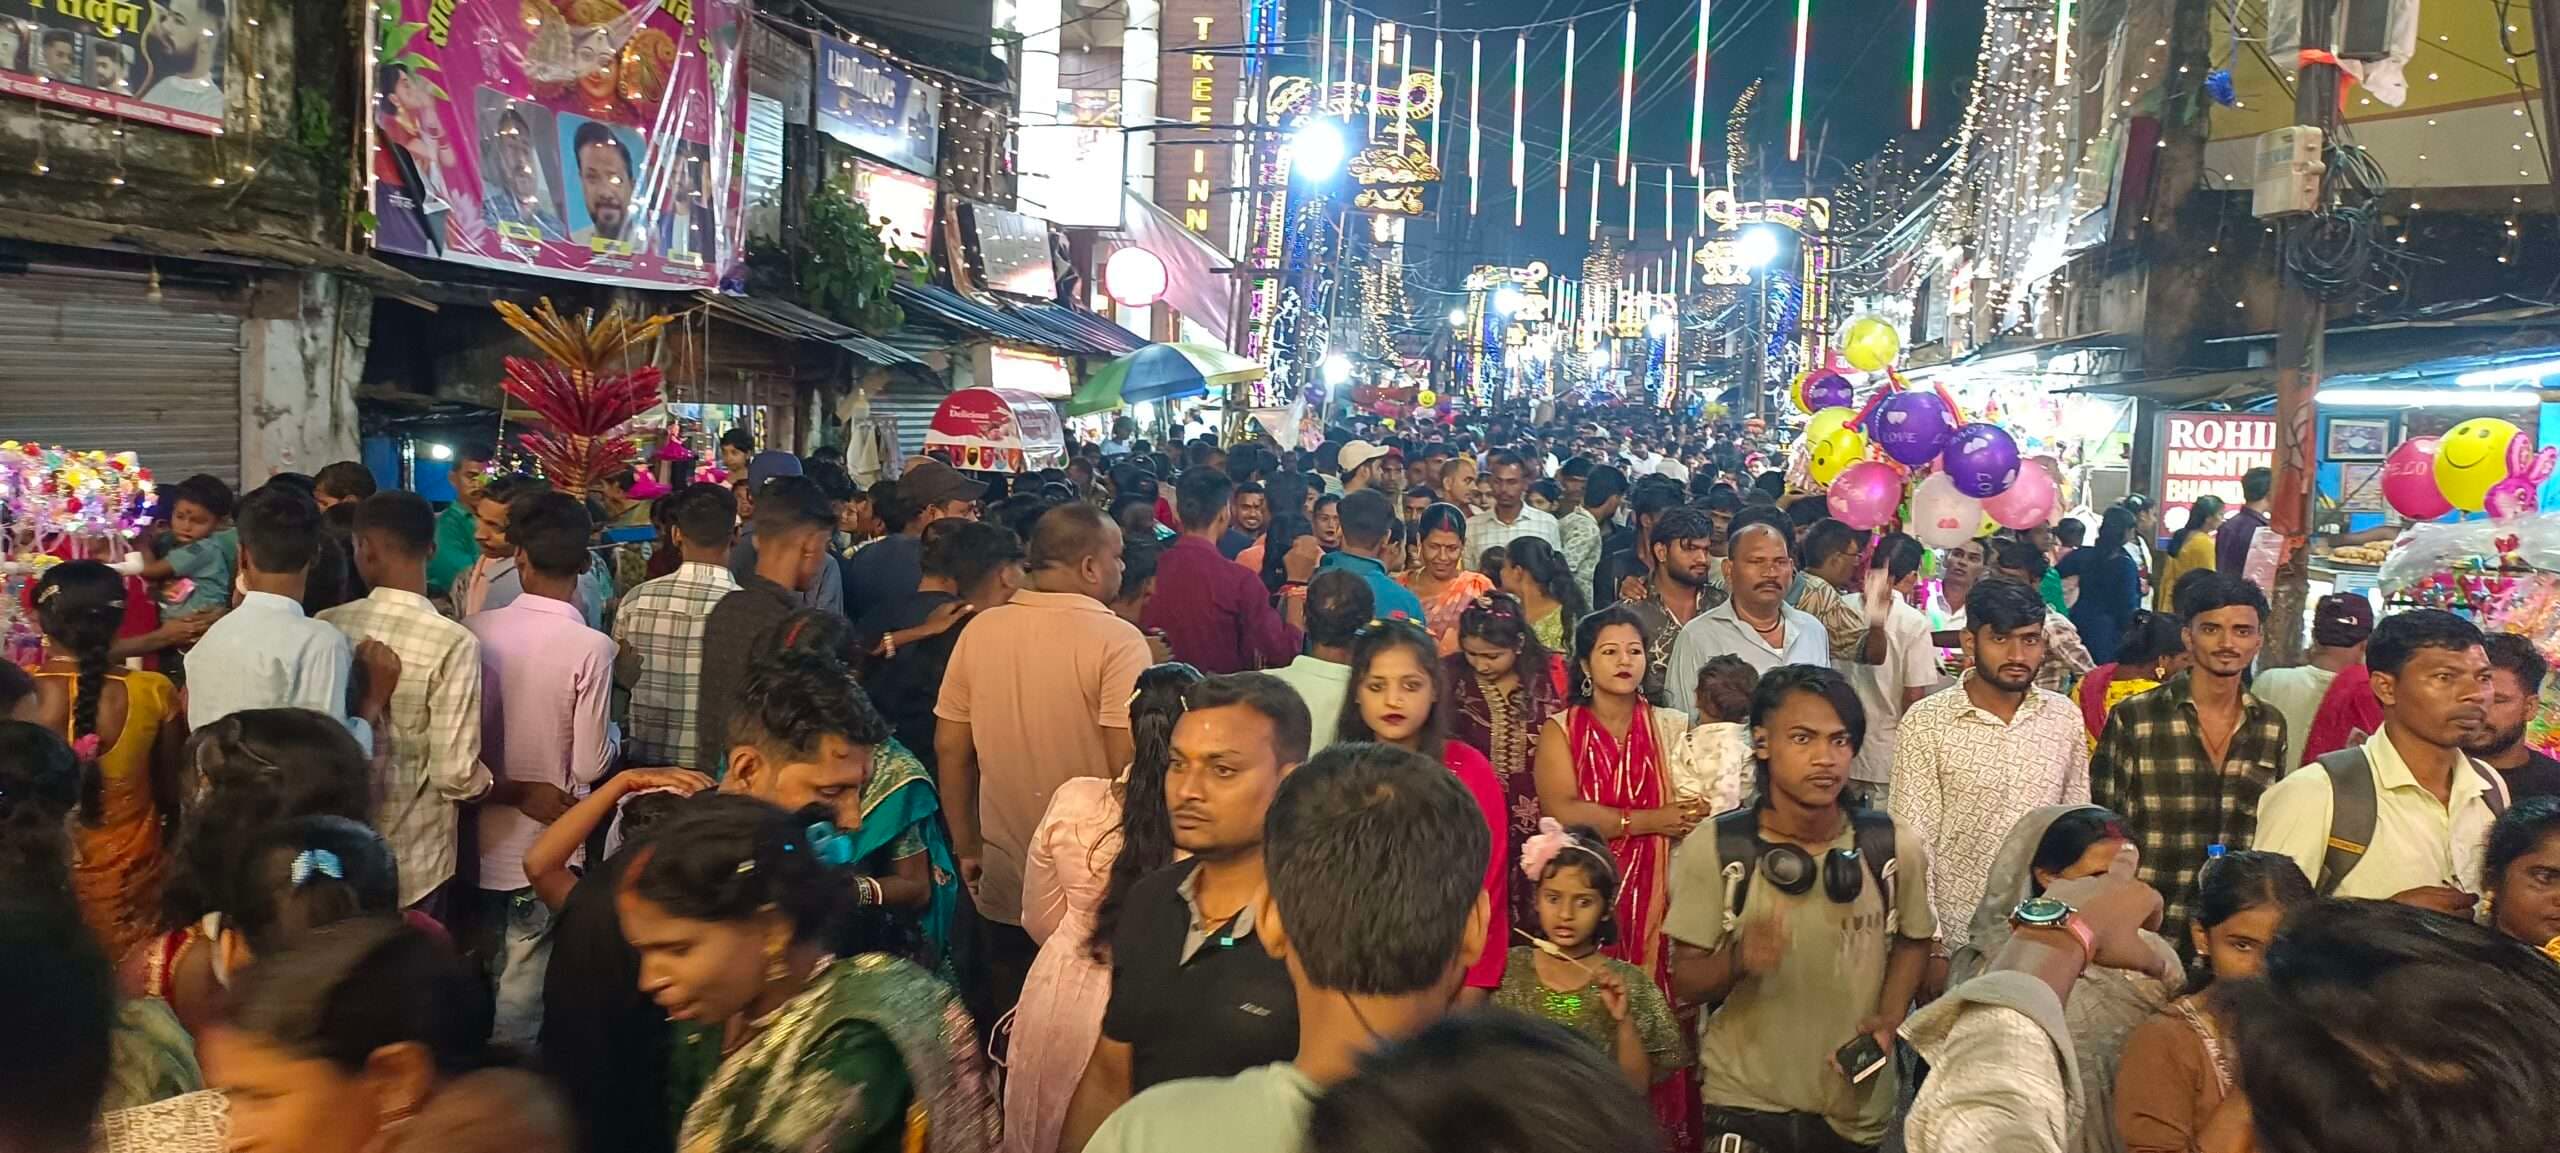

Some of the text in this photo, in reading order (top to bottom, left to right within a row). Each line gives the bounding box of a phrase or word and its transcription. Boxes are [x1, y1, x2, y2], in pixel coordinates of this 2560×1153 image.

[1185, 16, 1214, 232] TREE INN
[1882, 432, 1917, 444] LOVE
[2165, 479, 2246, 505] BHAND
